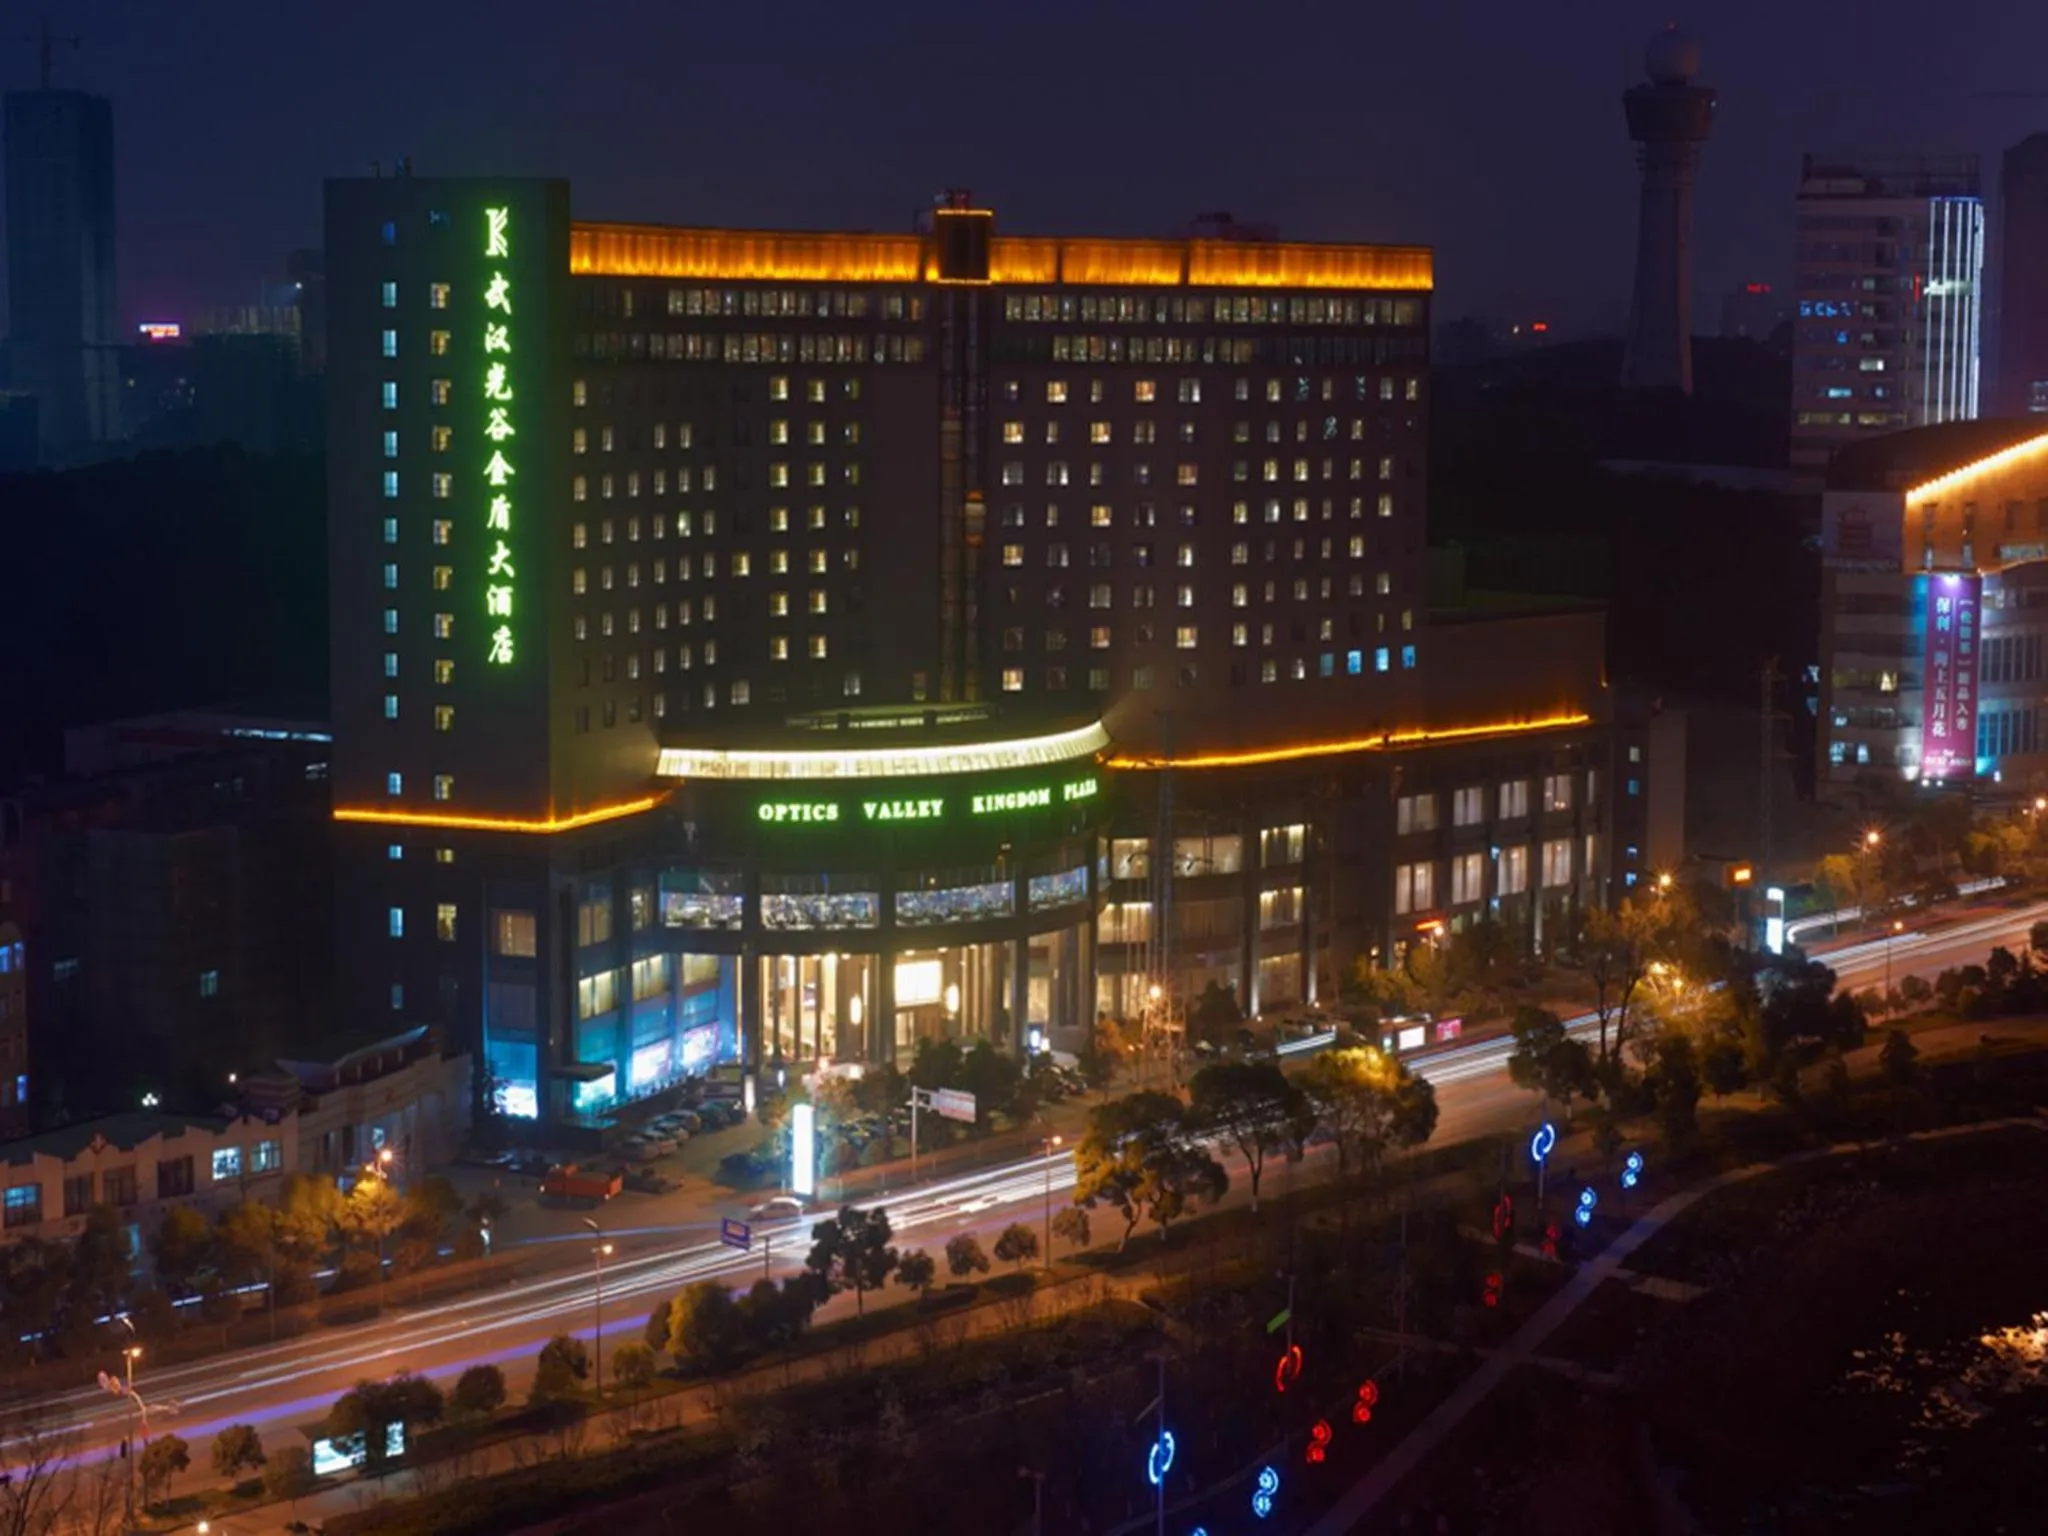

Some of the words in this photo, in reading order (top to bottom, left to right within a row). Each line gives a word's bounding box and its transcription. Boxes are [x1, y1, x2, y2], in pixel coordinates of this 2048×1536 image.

[484, 272, 515, 664] 武汉光谷金盾大酒店
[758, 804, 839, 821] OPTICS
[863, 799, 944, 819] VALLEY
[972, 788, 1051, 814] KINGDOM
[1064, 779, 1097, 801] PLAZA
